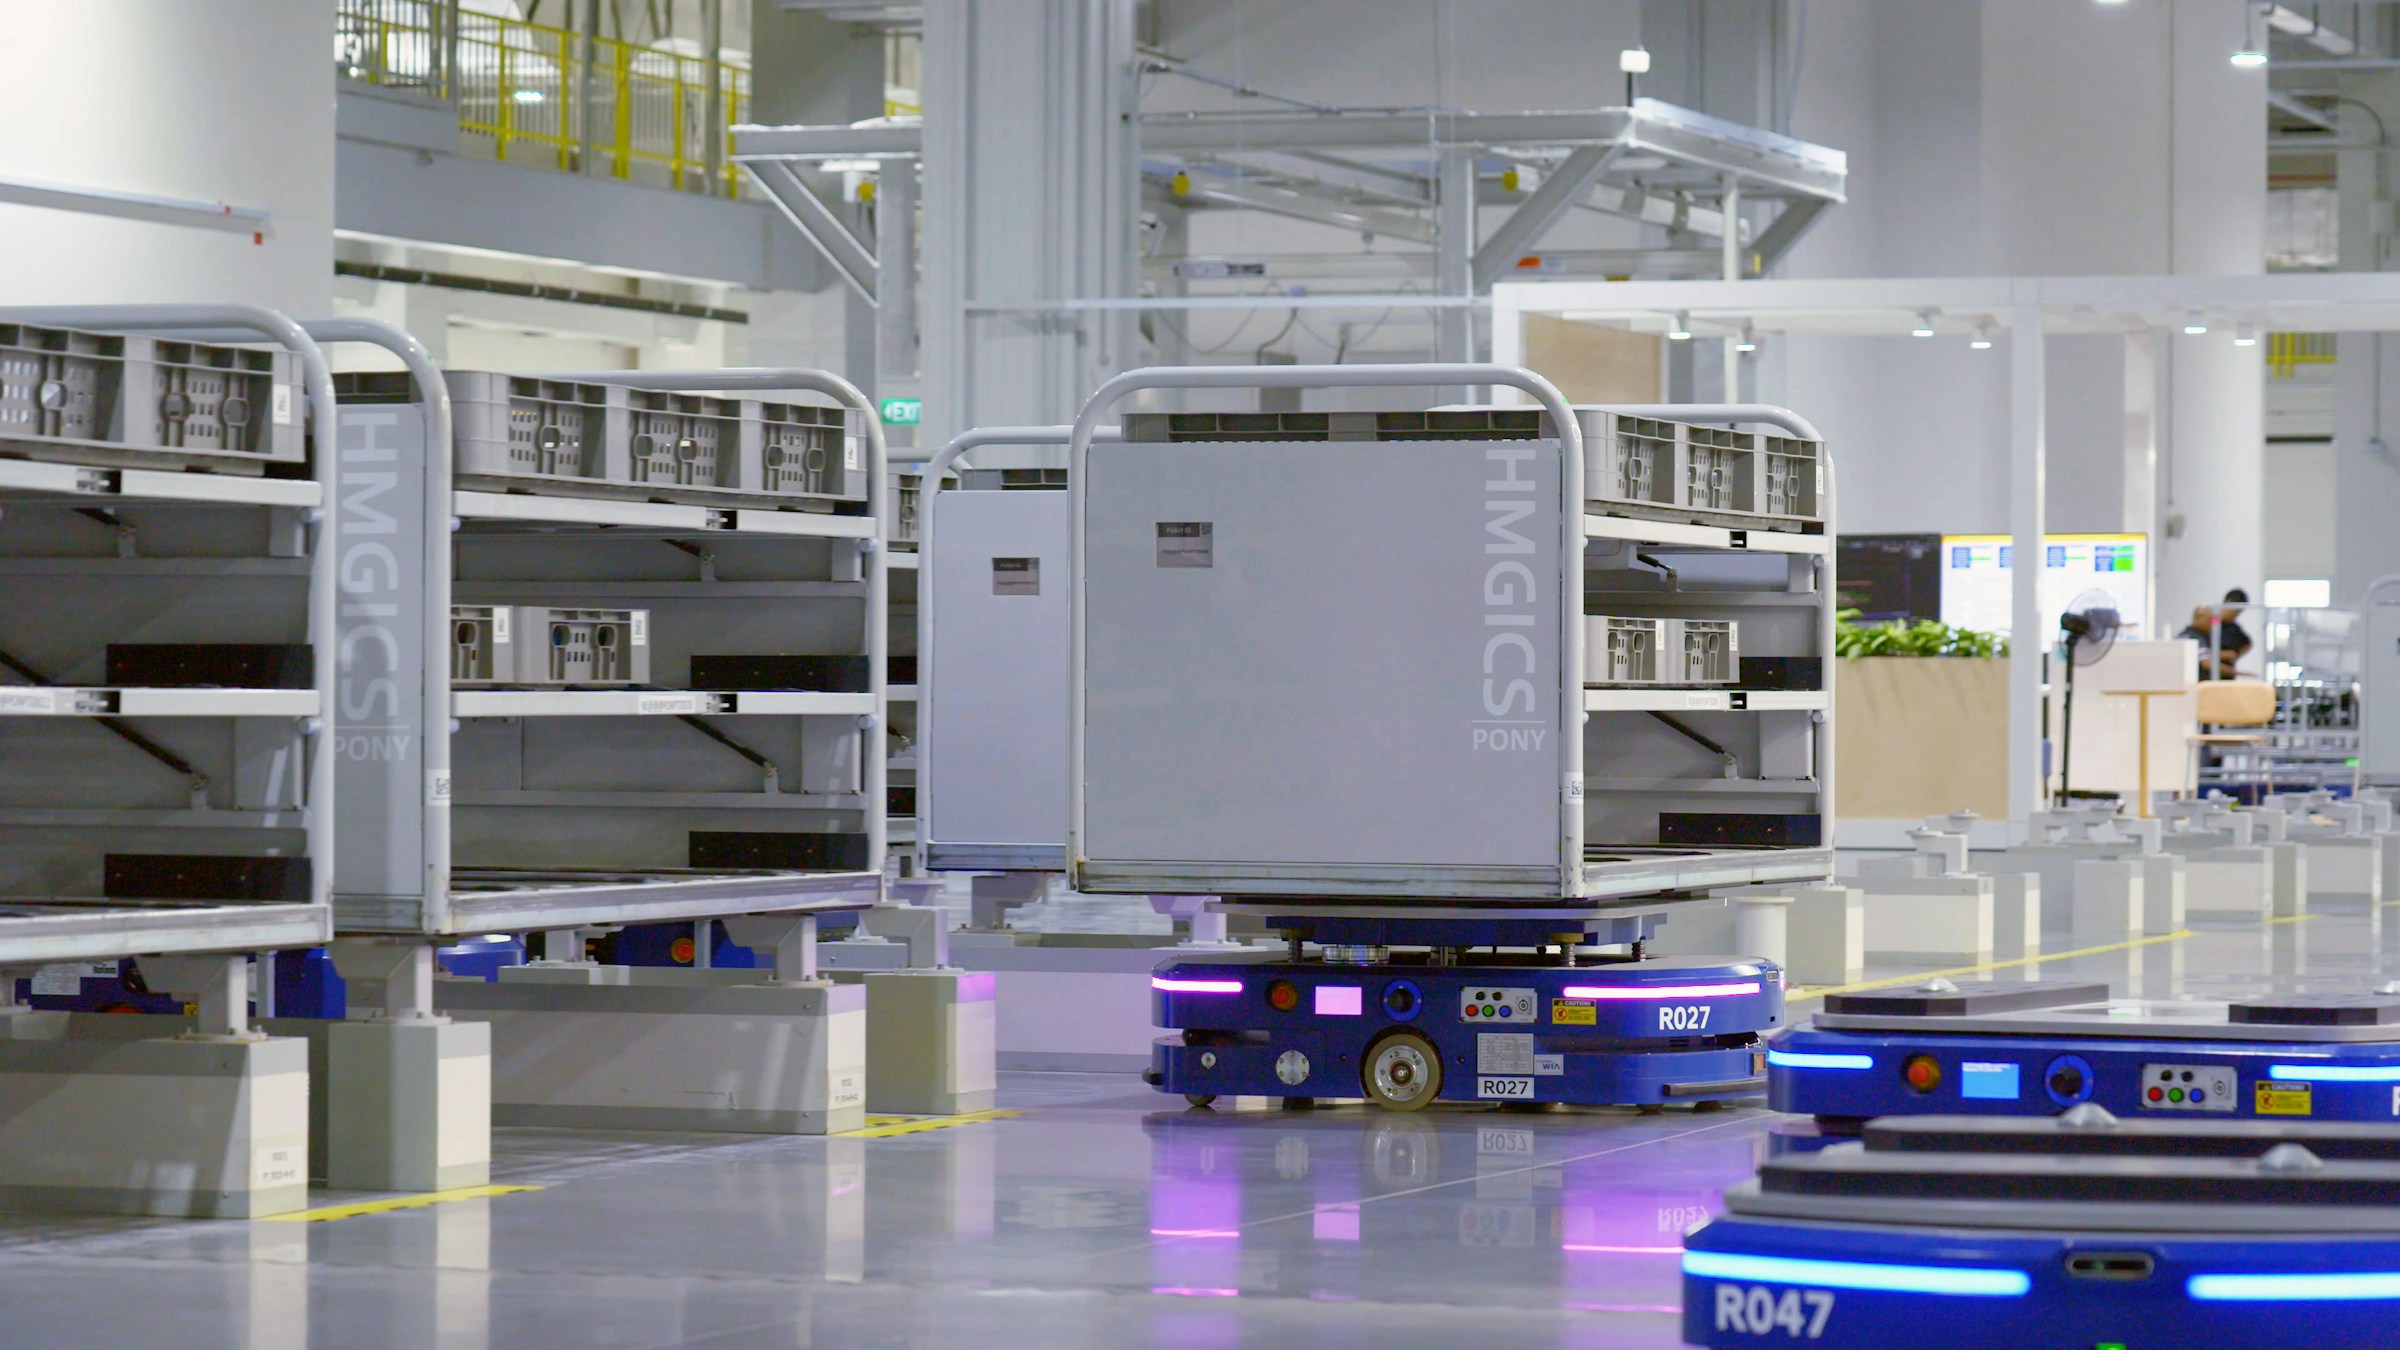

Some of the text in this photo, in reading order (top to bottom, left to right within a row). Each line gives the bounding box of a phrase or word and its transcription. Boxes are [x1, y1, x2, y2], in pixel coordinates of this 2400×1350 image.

[340, 412, 399, 721] HMGICS
[1482, 449, 1537, 717] HMGICS
[335, 734, 411, 761] PONY
[1472, 728, 1547, 752] PONY
[1658, 1005, 1712, 1031] R027
[1483, 1080, 1529, 1095] R027
[1714, 1282, 1836, 1340] R047
